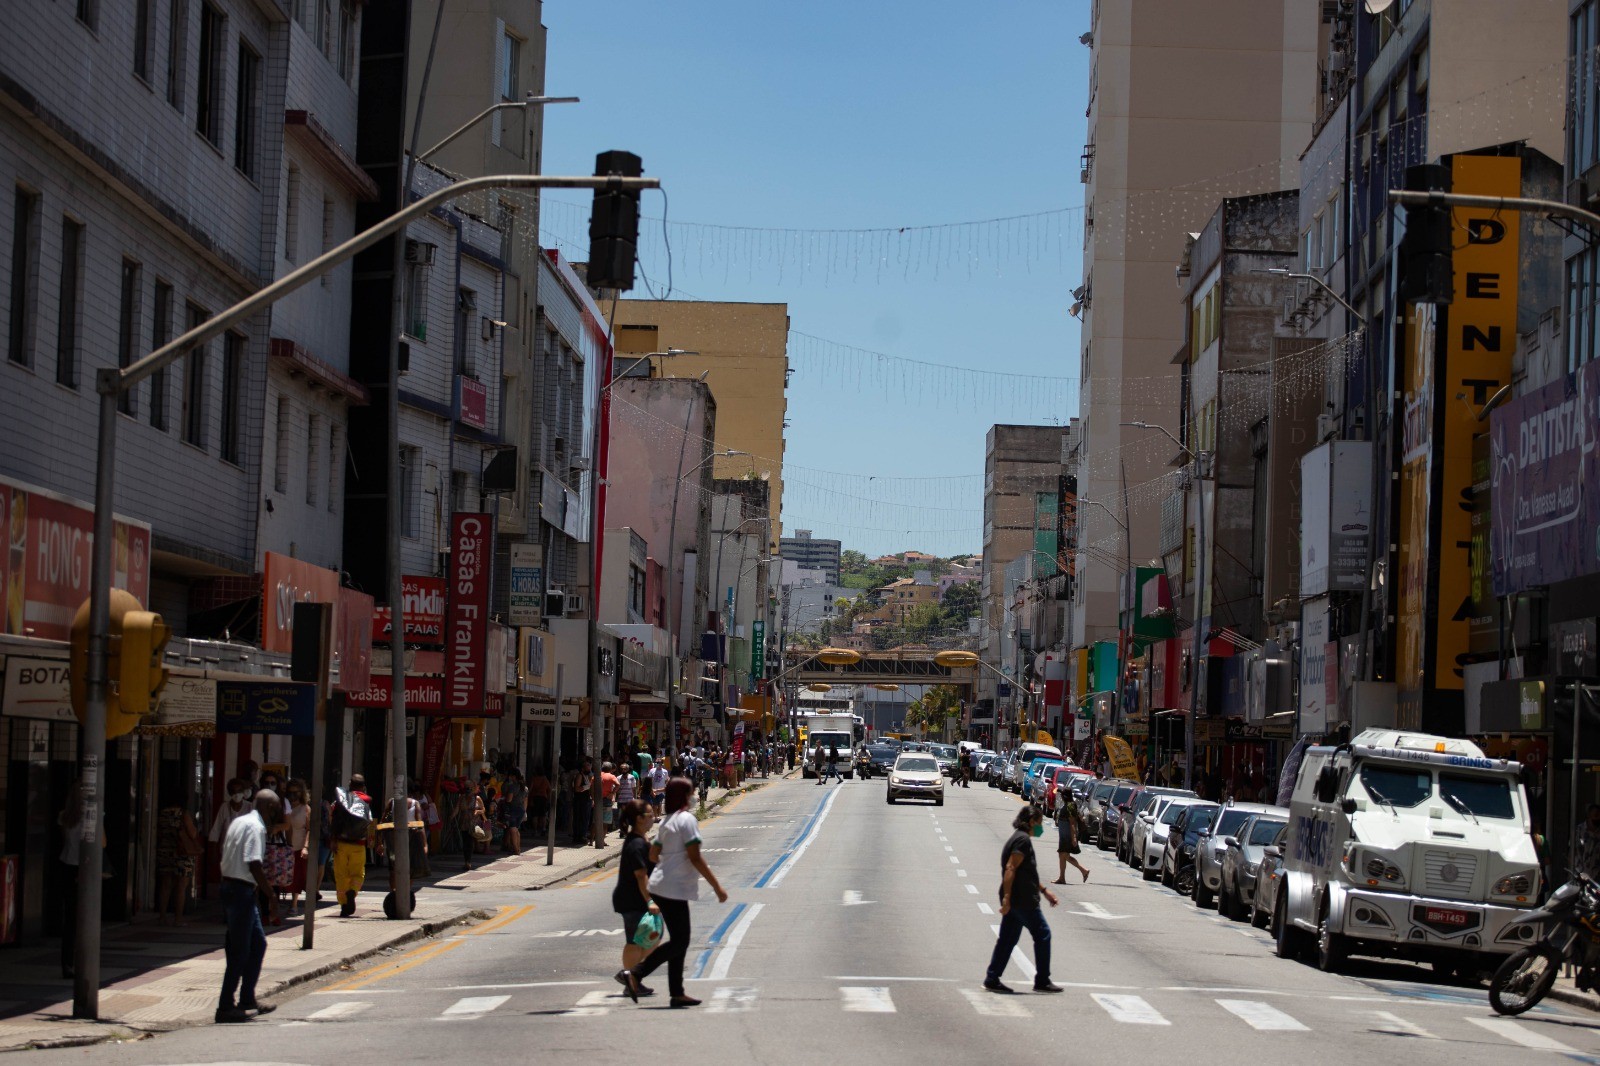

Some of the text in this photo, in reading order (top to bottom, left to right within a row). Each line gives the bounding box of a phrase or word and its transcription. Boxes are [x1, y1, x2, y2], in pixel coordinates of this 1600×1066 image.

[1519, 398, 1583, 470] DENTISTA
[1531, 491, 1556, 518] Vanessa
[1287, 457, 1302, 589] AVENUE
[37, 517, 81, 590] HONG
[457, 518, 482, 595] Casas
[402, 583, 418, 593] SAS
[512, 577, 540, 593] 3 HORAS
[402, 588, 445, 616] nklin
[382, 621, 439, 635] AFAIAS
[452, 604, 478, 707] Franklin
[403, 686, 441, 703] anklin
[549, 709, 571, 717] Bxo
[1452, 756, 1493, 769] BRINKS
[1526, 748, 1540, 763] oi
